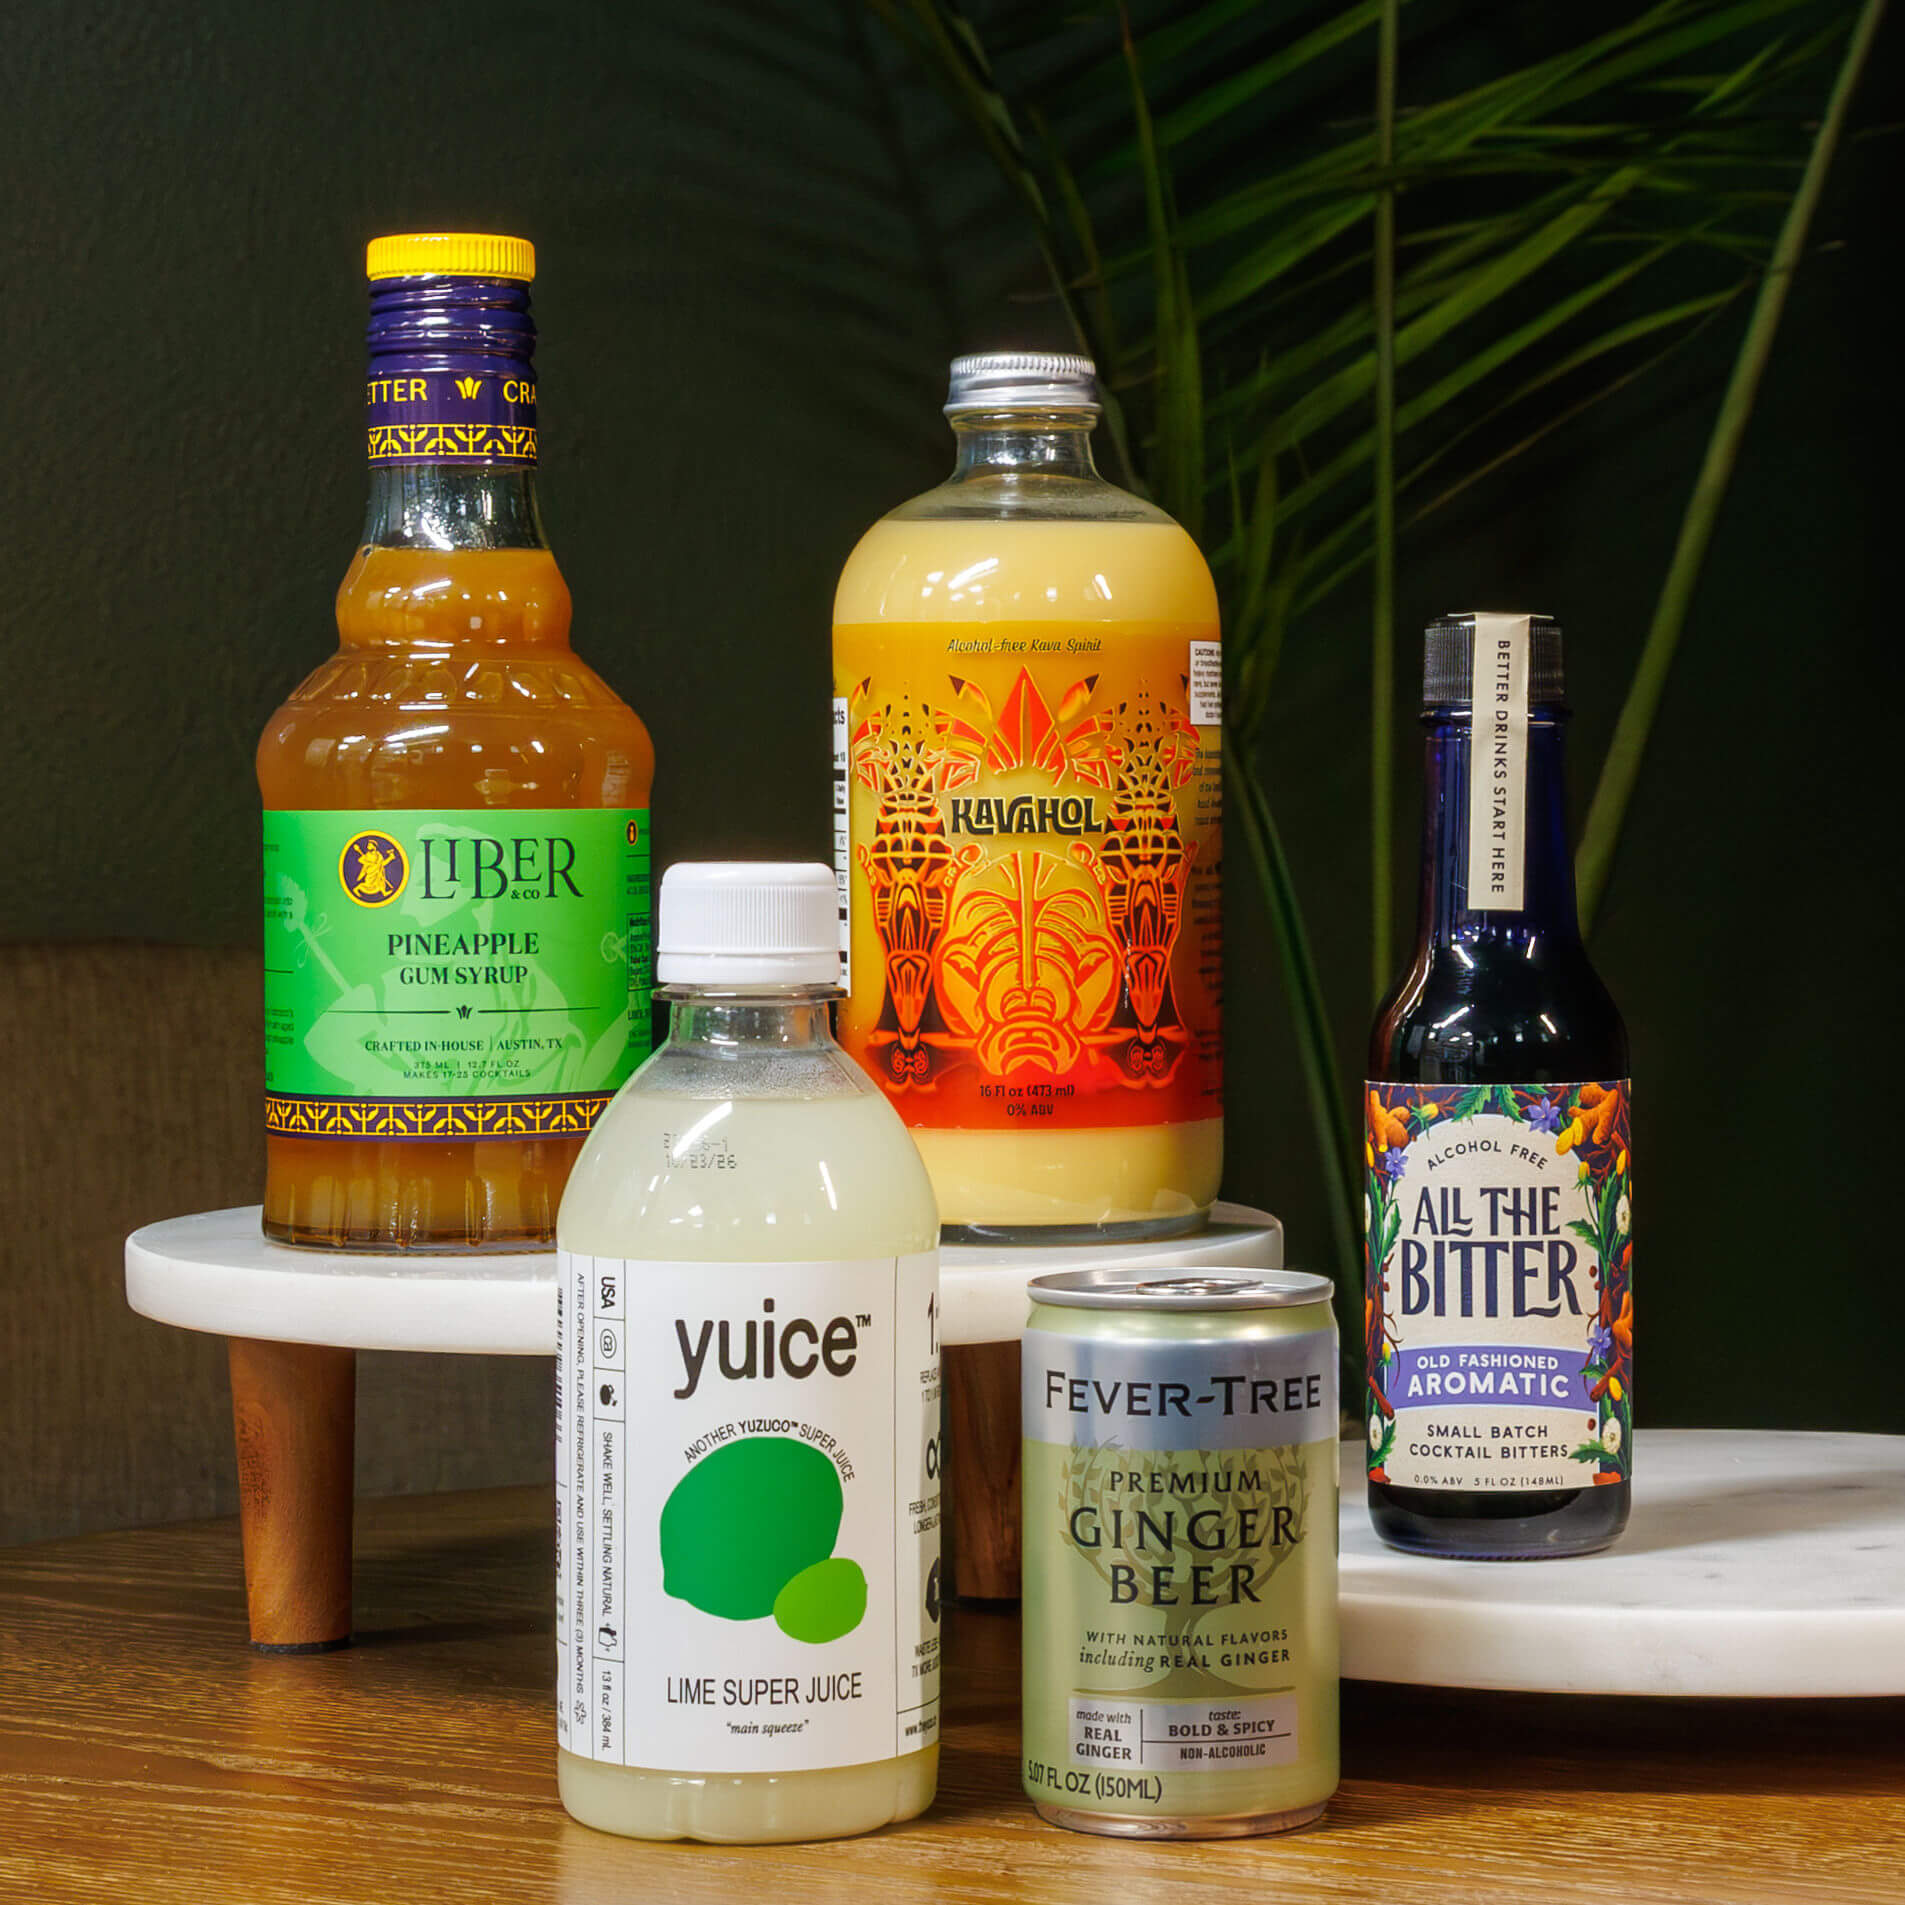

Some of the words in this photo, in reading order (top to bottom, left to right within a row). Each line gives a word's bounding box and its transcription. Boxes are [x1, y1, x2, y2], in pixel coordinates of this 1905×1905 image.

[367, 378, 428, 406] TTER
[1031, 639, 1061, 652] Kava
[1066, 638, 1101, 654] Spirit
[1495, 640, 1511, 702] BETTER
[1493, 710, 1509, 779] DRINKS
[951, 796, 1103, 835] KAVAHOL
[1492, 787, 1507, 840] START
[420, 837, 585, 900] LIBER
[1491, 848, 1505, 893] HERE
[388, 932, 540, 956] PINEAPPLE
[400, 967, 449, 985] GUM
[455, 965, 528, 985] SYRUP
[365, 1041, 421, 1051] CRAFTED
[498, 1039, 545, 1050] AUSTIN,
[548, 1038, 563, 1049] TX
[403, 1071, 439, 1079] MAKES
[472, 1069, 531, 1078] COCKTAILS
[979, 1085, 992, 1097] 16
[1008, 1087, 1024, 1097] oz
[1027, 1084, 1052, 1097] (473
[1007, 1103, 1026, 1116] 0%
[1426, 1139, 1502, 1171] ALCOHOL
[1509, 1143, 1549, 1170] FREE
[1413, 1186, 1473, 1237] ALL
[1479, 1186, 1561, 1236] THE
[576, 1272, 585, 1310] AFTER
[601, 1276, 616, 1309] USA
[1401, 1239, 1584, 1318] BITTER
[1416, 1355, 1451, 1369] OLD
[1459, 1353, 1559, 1370] FASHIONED
[576, 1369, 584, 1412] PLEASE
[1046, 1370, 1321, 1417] FEVER-TREE
[1407, 1371, 1570, 1398] AROMATIC
[1426, 1424, 1482, 1439] SMALL
[1490, 1425, 1549, 1439] BATCH
[576, 1415, 584, 1493] REFRIGERATE
[602, 1431, 613, 1470] SHAKE
[684, 1423, 737, 1463] ANOTHER
[799, 1423, 837, 1453] SUPER
[832, 1449, 855, 1483] JUICE
[1409, 1443, 1492, 1459] COCKTAIL
[1500, 1444, 1568, 1459] BITTERS
[602, 1473, 613, 1505] WELL,
[1110, 1470, 1262, 1493] PREMIUM
[1414, 1474, 1438, 1485] 0.0%
[1441, 1476, 1463, 1486] ABV
[1473, 1478, 1480, 1486] 5
[1485, 1477, 1496, 1487] FL
[1500, 1476, 1516, 1487] OZ
[1520, 1475, 1564, 1487] (148ML)
[576, 1495, 584, 1519] AND
[576, 1521, 584, 1544] USE
[602, 1508, 613, 1563] SETTLING
[1070, 1506, 1300, 1552] GINGER
[576, 1547, 584, 1587] WITHIN
[601, 1566, 613, 1616] NATURAL
[1110, 1564, 1262, 1606] BEER
[576, 1590, 584, 1627] THREE
[1087, 1631, 1126, 1645] WITH
[1133, 1634, 1214, 1647] NATURAL
[1221, 1629, 1288, 1645] FLAVORS
[576, 1645, 584, 1694] MONTHS
[1080, 1646, 1155, 1672] including
[1160, 1655, 1211, 1668] REAL
[1220, 1649, 1290, 1667] GINGER
[601, 1670, 612, 1682] 13
[667, 1677, 716, 1705] LIME
[723, 1677, 800, 1706] SUPER
[805, 1672, 862, 1704] JUICE
[601, 1714, 612, 1733] 384
[1076, 1711, 1104, 1723] made
[1108, 1713, 1132, 1724] with
[1168, 1725, 1212, 1737] BOLD
[1217, 1724, 1229, 1736] &
[1233, 1720, 1275, 1735] SPICY
[1208, 1710, 1241, 1722] taste:
[1084, 1727, 1122, 1742] REAL
[1076, 1743, 1132, 1760] GINGER
[1180, 1744, 1266, 1760] NON-ALCOHOLIC
[1047, 1766, 1062, 1790] FL
[1065, 1771, 1091, 1795] OZ
[1095, 1772, 1162, 1804] (150ML)
